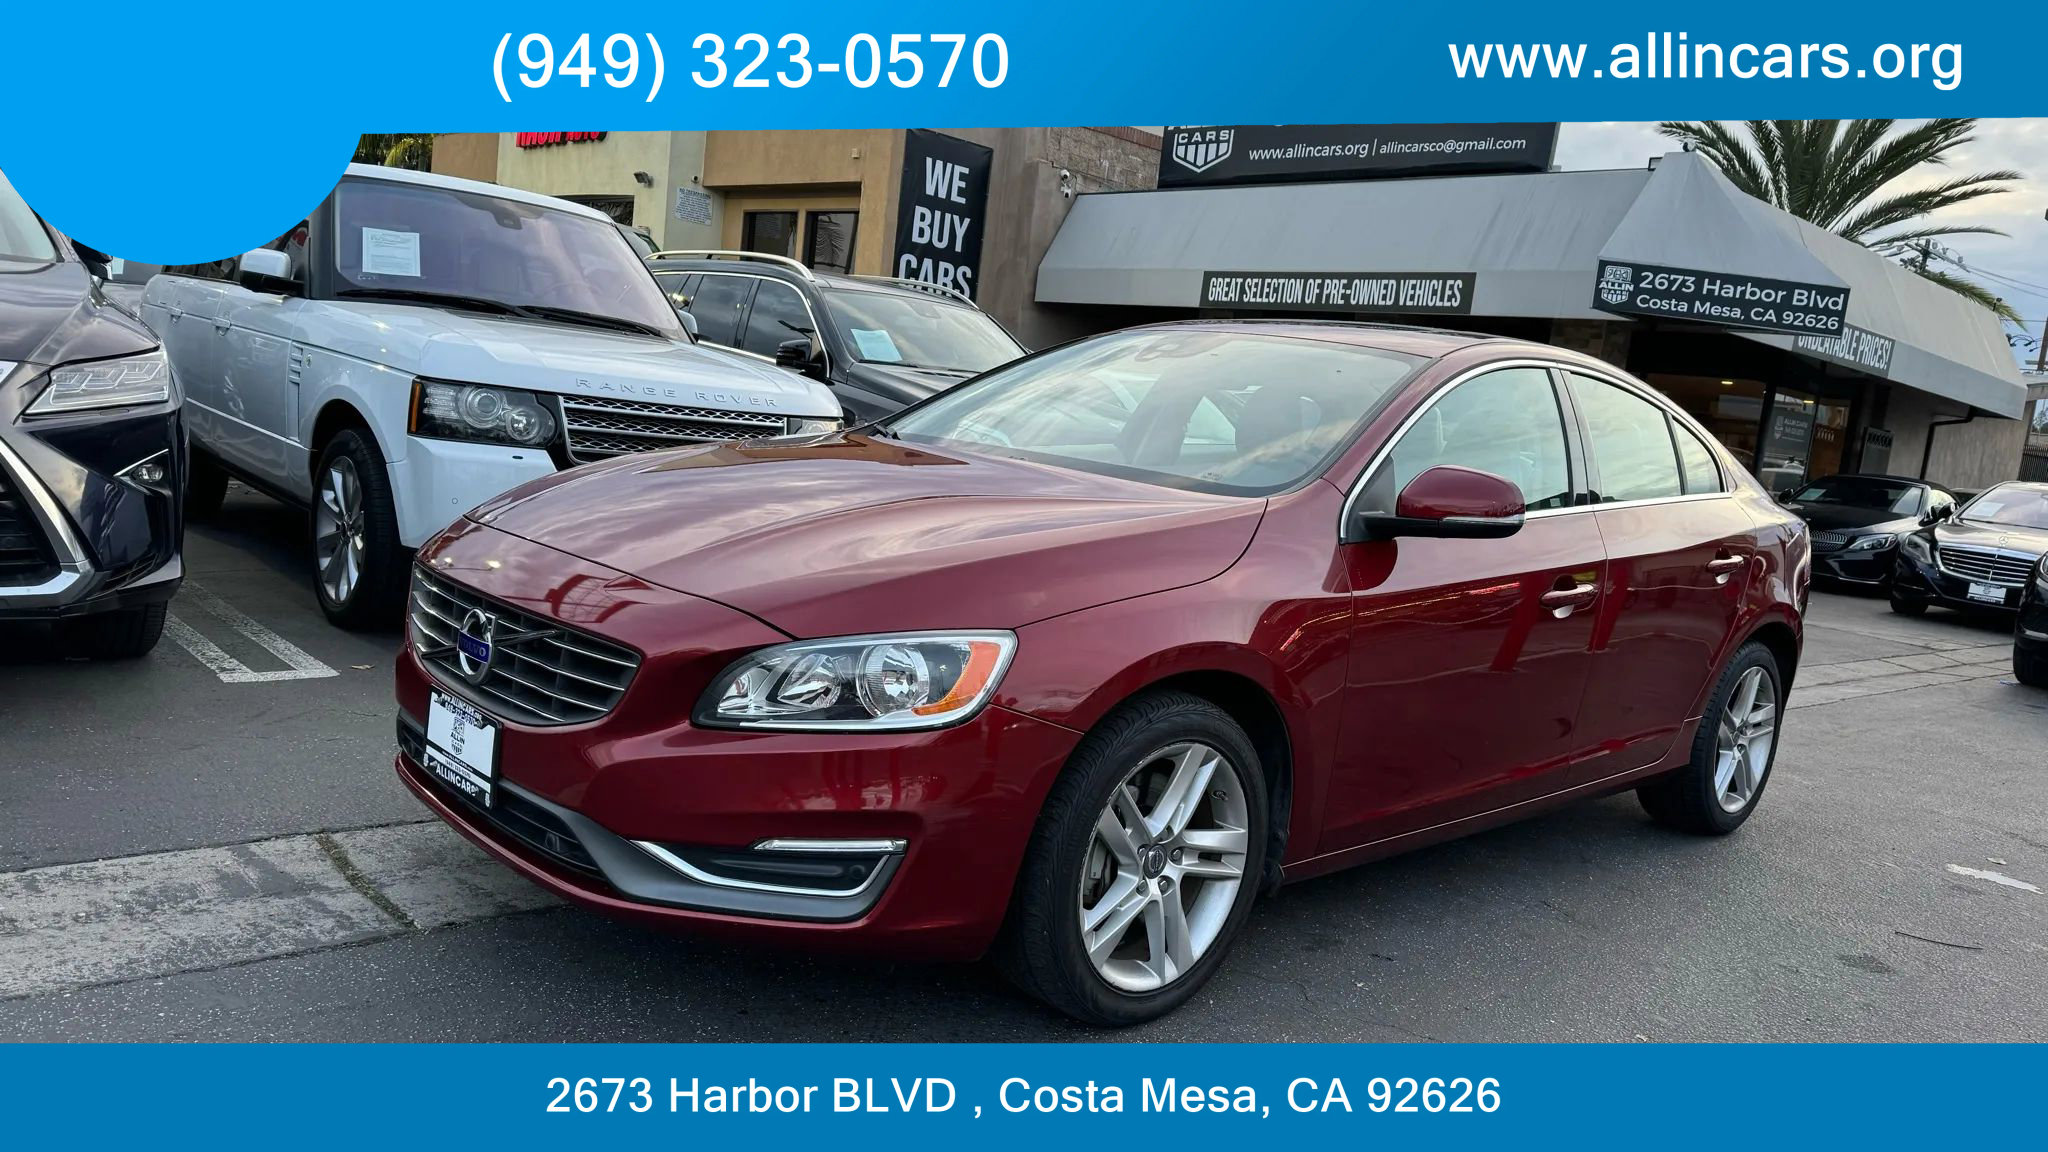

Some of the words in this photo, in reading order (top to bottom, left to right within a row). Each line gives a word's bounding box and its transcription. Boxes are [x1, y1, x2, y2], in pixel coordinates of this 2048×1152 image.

[1178, 129, 1231, 144] CARS
[1249, 142, 1369, 161] www.allincars.org
[1379, 137, 1527, 154] allincarsco@gmail.com
[925, 156, 970, 205] WE
[911, 205, 971, 253] BUY
[898, 253, 972, 299] CARS
[1208, 277, 1244, 302] GREAT
[1243, 278, 1305, 304] SELECTION
[1305, 278, 1323, 304] OF
[1321, 278, 1397, 306] PRE-OWNED
[1398, 279, 1463, 307] VEHICLES
[1599, 281, 1635, 292] ALLIN
[1639, 271, 1696, 293] 2673
[1702, 278, 1787, 304] Harbor
[1792, 288, 1845, 311] Blvd
[1636, 294, 1689, 313] Costa
[1693, 300, 1745, 320] Mesa,
[1750, 307, 1777, 323] CA
[1782, 311, 1839, 330] 92626
[1856, 332, 1892, 370] PRICES!
[575, 377, 676, 398] RANGE
[695, 390, 778, 407] ROVER
